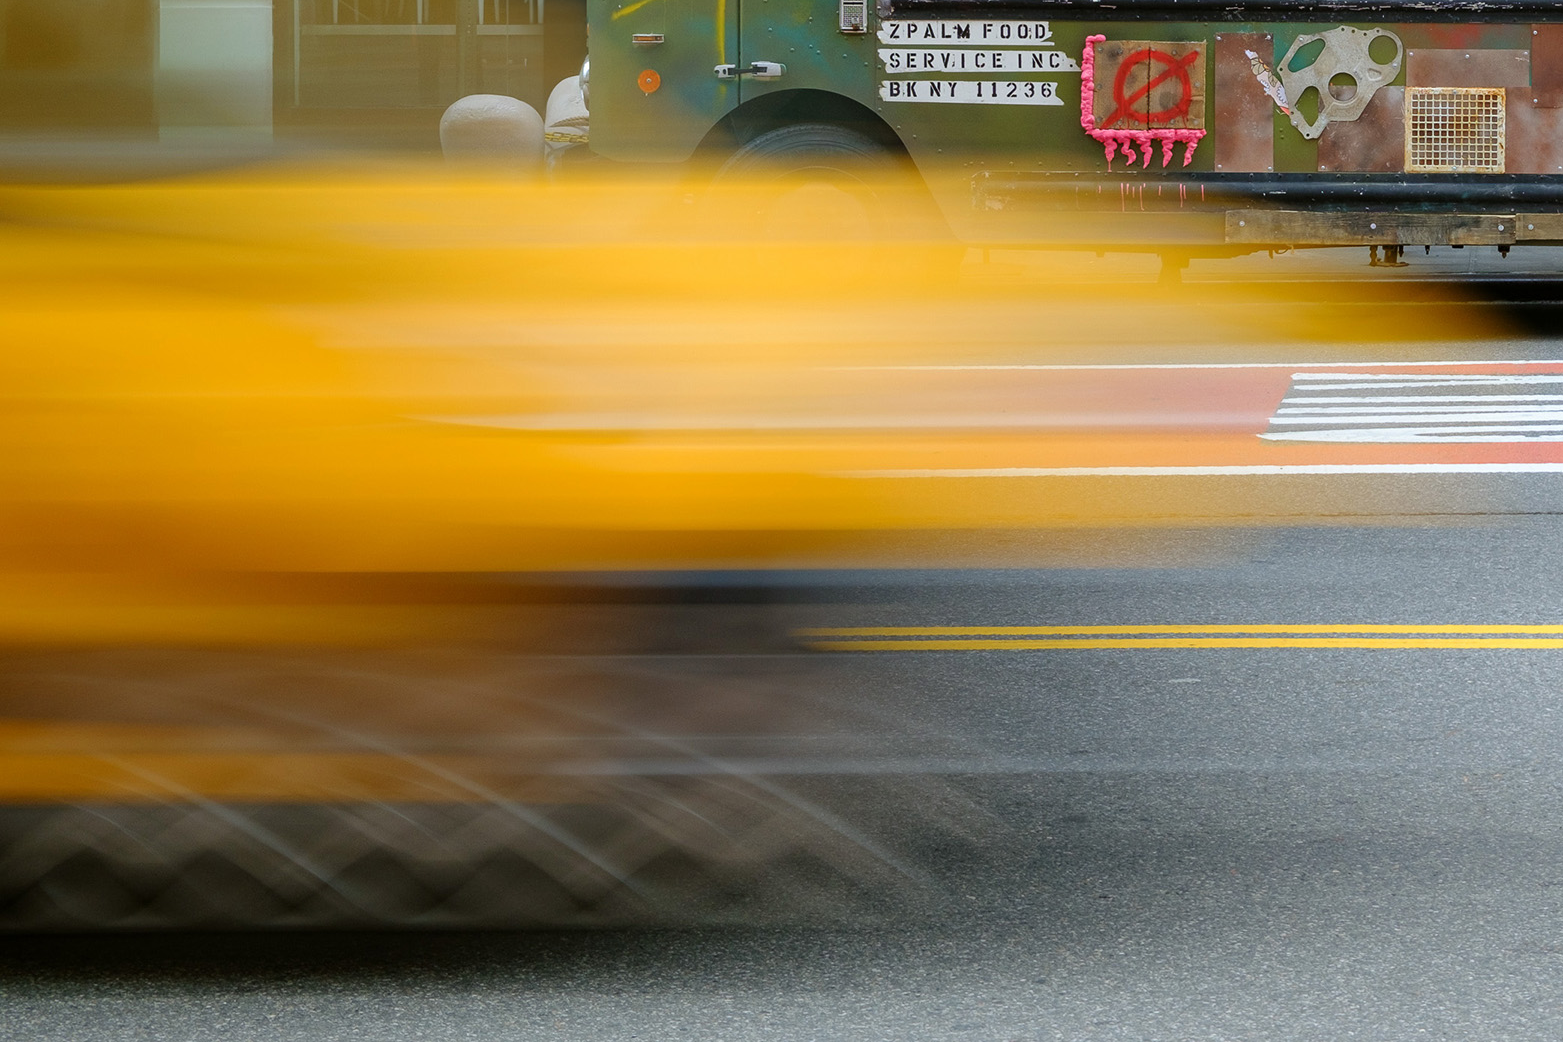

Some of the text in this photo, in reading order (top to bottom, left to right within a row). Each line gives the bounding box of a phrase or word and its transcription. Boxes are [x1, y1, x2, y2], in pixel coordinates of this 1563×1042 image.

[982, 23, 1046, 39] FOOD
[889, 52, 1074, 69] SERVICE INC.
[889, 82, 1052, 98] BK NY 11236
